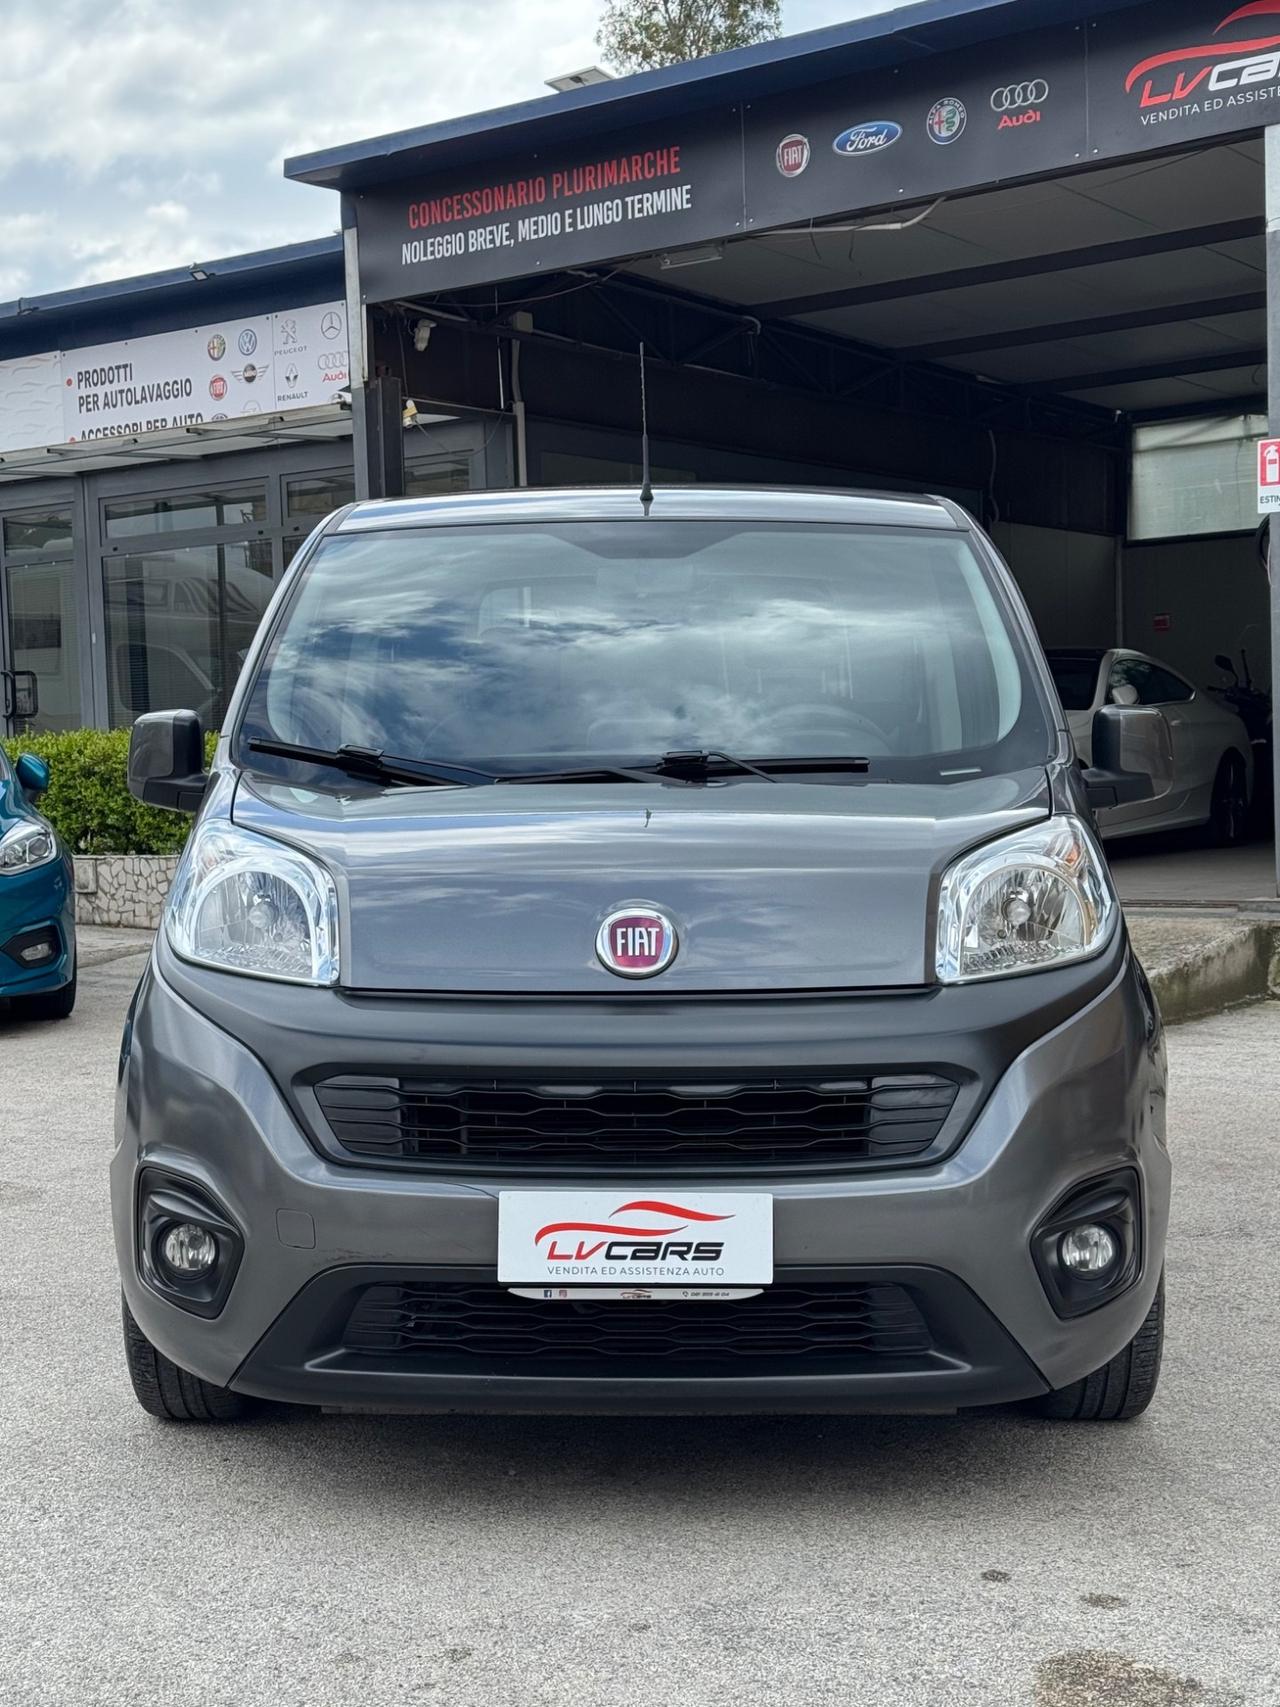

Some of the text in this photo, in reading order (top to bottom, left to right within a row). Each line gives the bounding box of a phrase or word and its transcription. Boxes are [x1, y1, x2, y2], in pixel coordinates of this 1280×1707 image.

[1140, 51, 1280, 108] LVCA
[997, 110, 1041, 130] Audi
[1140, 103, 1200, 126] VENDITA
[1204, 98, 1223, 112] ED
[846, 126, 888, 151] Ford
[783, 145, 803, 166] FIAT
[408, 146, 681, 229] CONCESSONARIO PLURIMARCHE
[402, 185, 692, 265] NOLEGGIO BREVE, MEDIO E LUNGO TERMINE
[77, 362, 133, 389] PRODOTTI
[78, 394, 100, 414] PER
[103, 377, 192, 410] AUTOLAVAGGIO
[277, 391, 309, 402] RENAULT
[616, 927, 660, 957] FIAT
[547, 1266, 725, 1276] VENDITA ED ASSISTENZA AUTO
